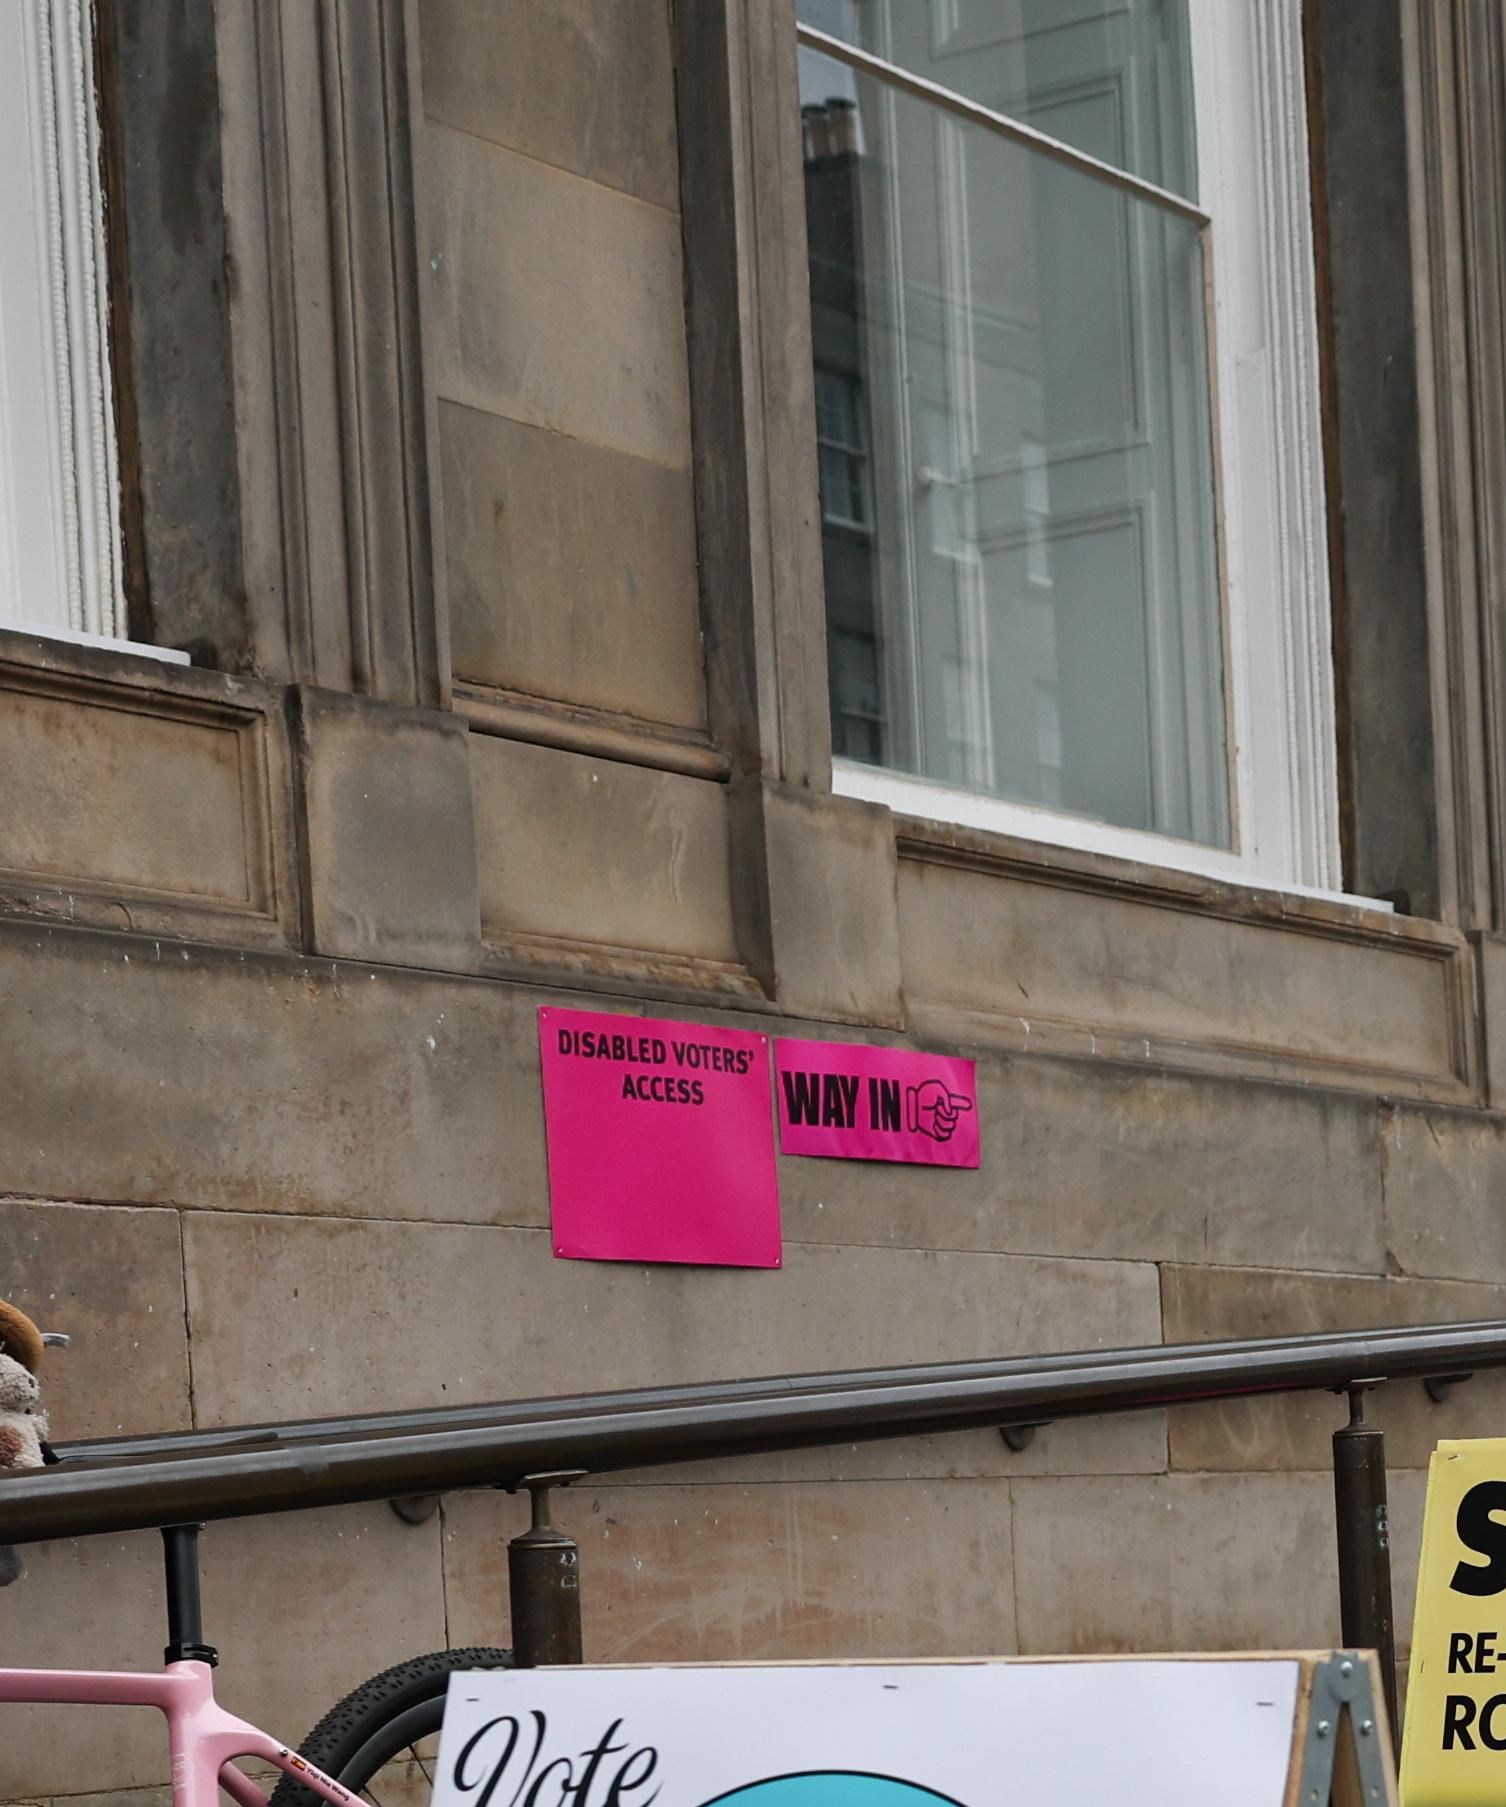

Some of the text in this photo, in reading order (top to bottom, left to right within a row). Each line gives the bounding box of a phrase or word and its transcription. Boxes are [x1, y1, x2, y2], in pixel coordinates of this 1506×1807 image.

[558, 1029, 666, 1065] DISABLED
[622, 1074, 703, 1105] ACCESS
[781, 1071, 900, 1132] WAY IN
